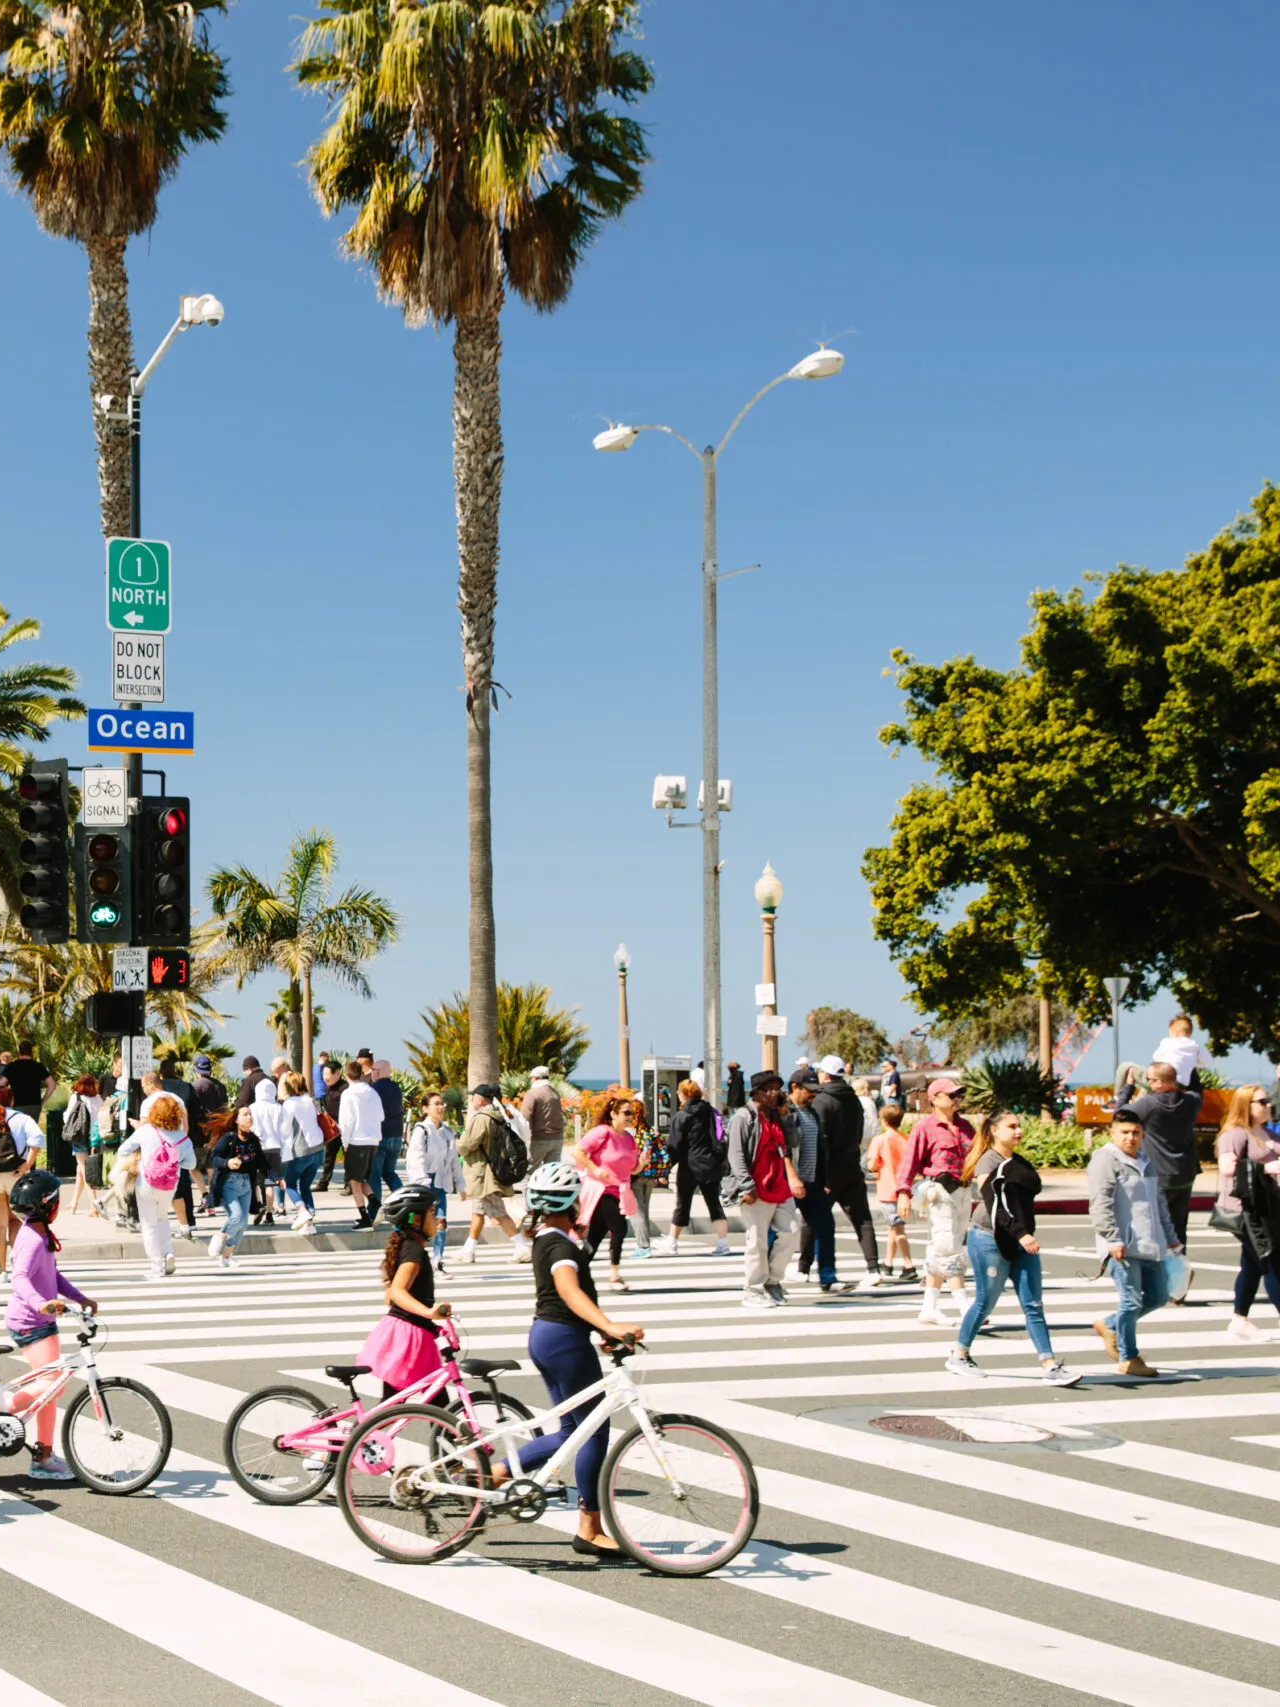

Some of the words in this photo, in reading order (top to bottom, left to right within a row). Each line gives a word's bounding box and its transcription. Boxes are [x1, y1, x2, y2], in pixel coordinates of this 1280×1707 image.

[136, 557, 142, 577] 1
[112, 587, 166, 606] NORTH
[117, 641, 133, 657] DO
[137, 643, 160, 658] NOT
[116, 663, 161, 680] BLOCK
[116, 683, 161, 697] INTERSECTION
[96, 713, 185, 740] Ocean
[86, 805, 123, 817] SIGNAL
[116, 949, 144, 957] DIAGONAL
[116, 957, 143, 965] CROSSING
[115, 970, 127, 986] OK
[179, 960, 186, 983] 3
